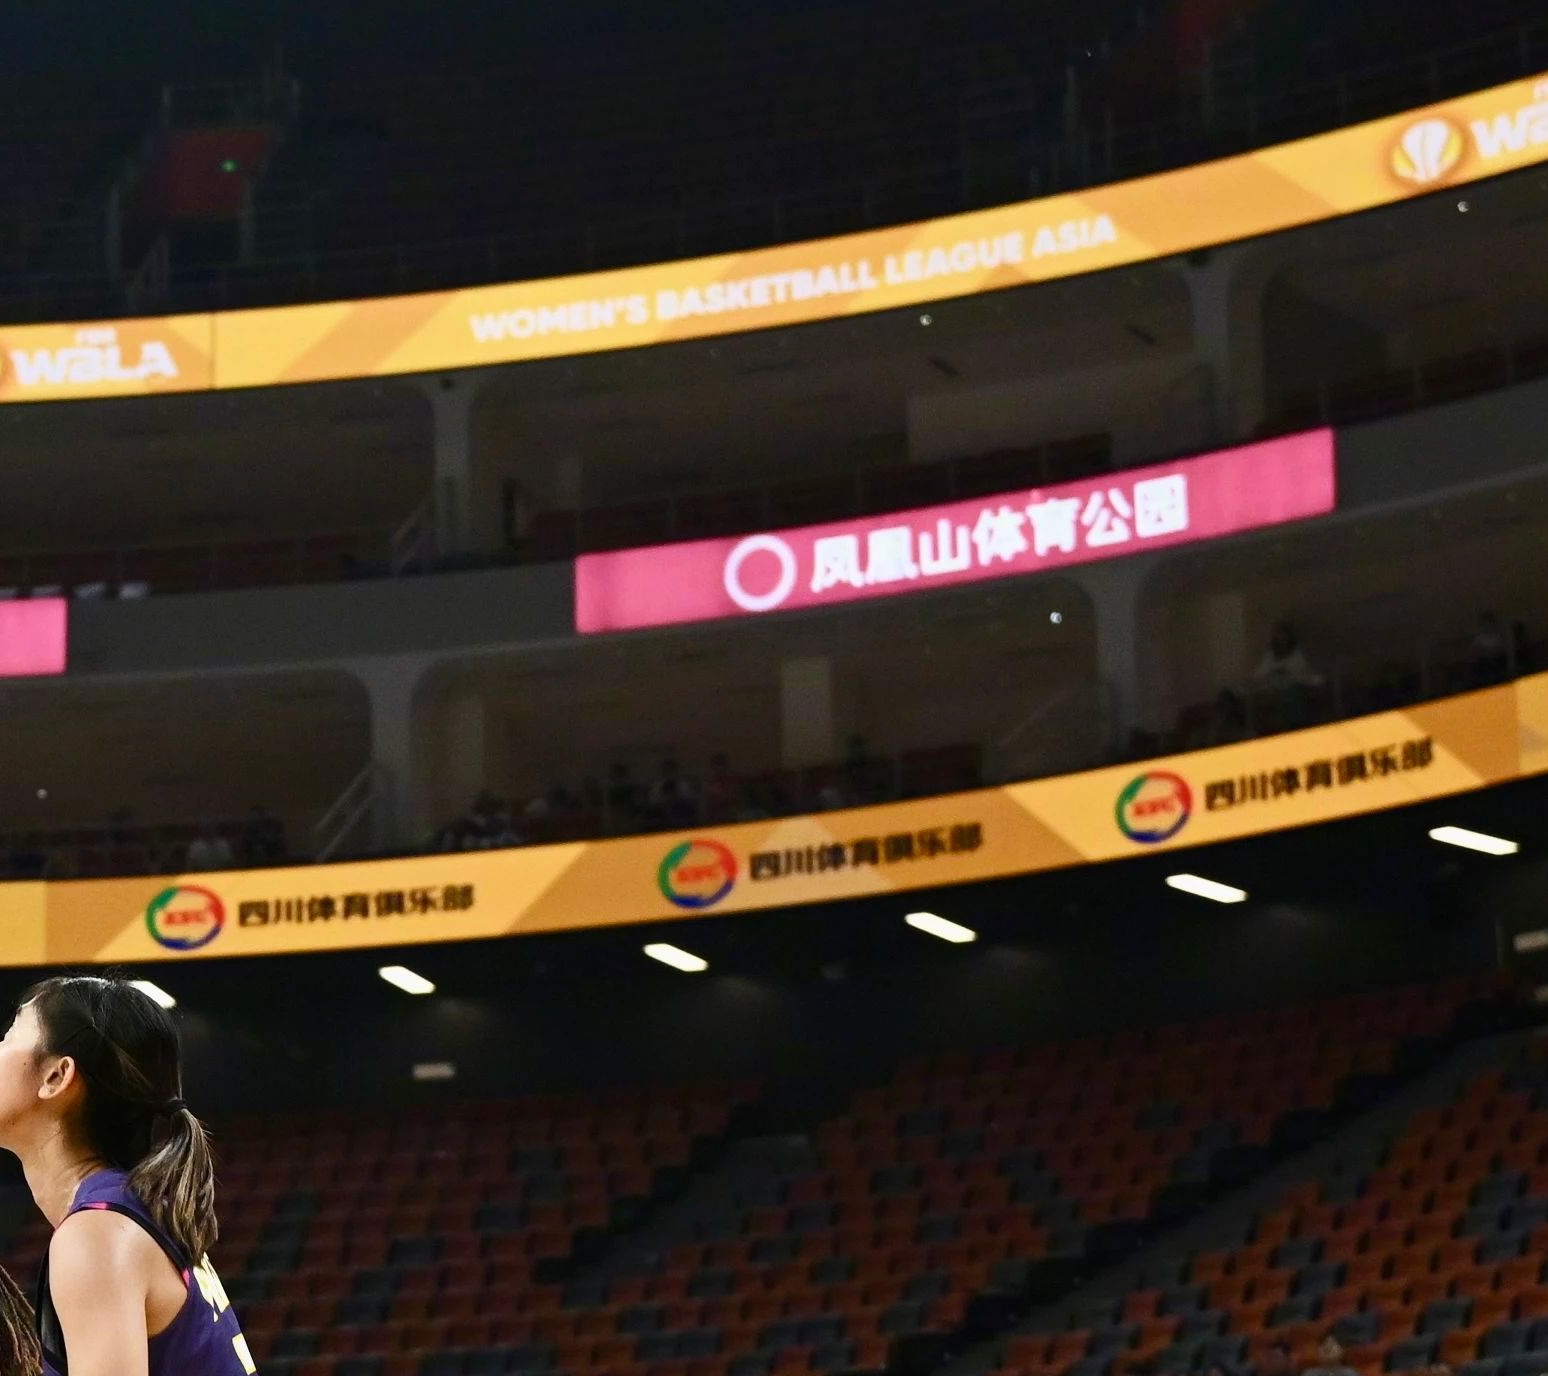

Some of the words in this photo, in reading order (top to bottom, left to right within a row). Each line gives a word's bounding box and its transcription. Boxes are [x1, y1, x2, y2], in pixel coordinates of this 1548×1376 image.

[470, 291, 648, 343] WOMEN'S
[656, 261, 877, 320] BASKETBALL
[885, 234, 1024, 284] LEAGUE
[1032, 214, 1118, 260] ASIA
[10, 340, 179, 385] WBLA
[809, 474, 1189, 593] 凤凰山体育公园
[1203, 737, 1435, 813] 四川体育俱乐部
[748, 823, 984, 881] 四川体育俱乐部
[237, 882, 475, 923] 四川体育俱乐部
